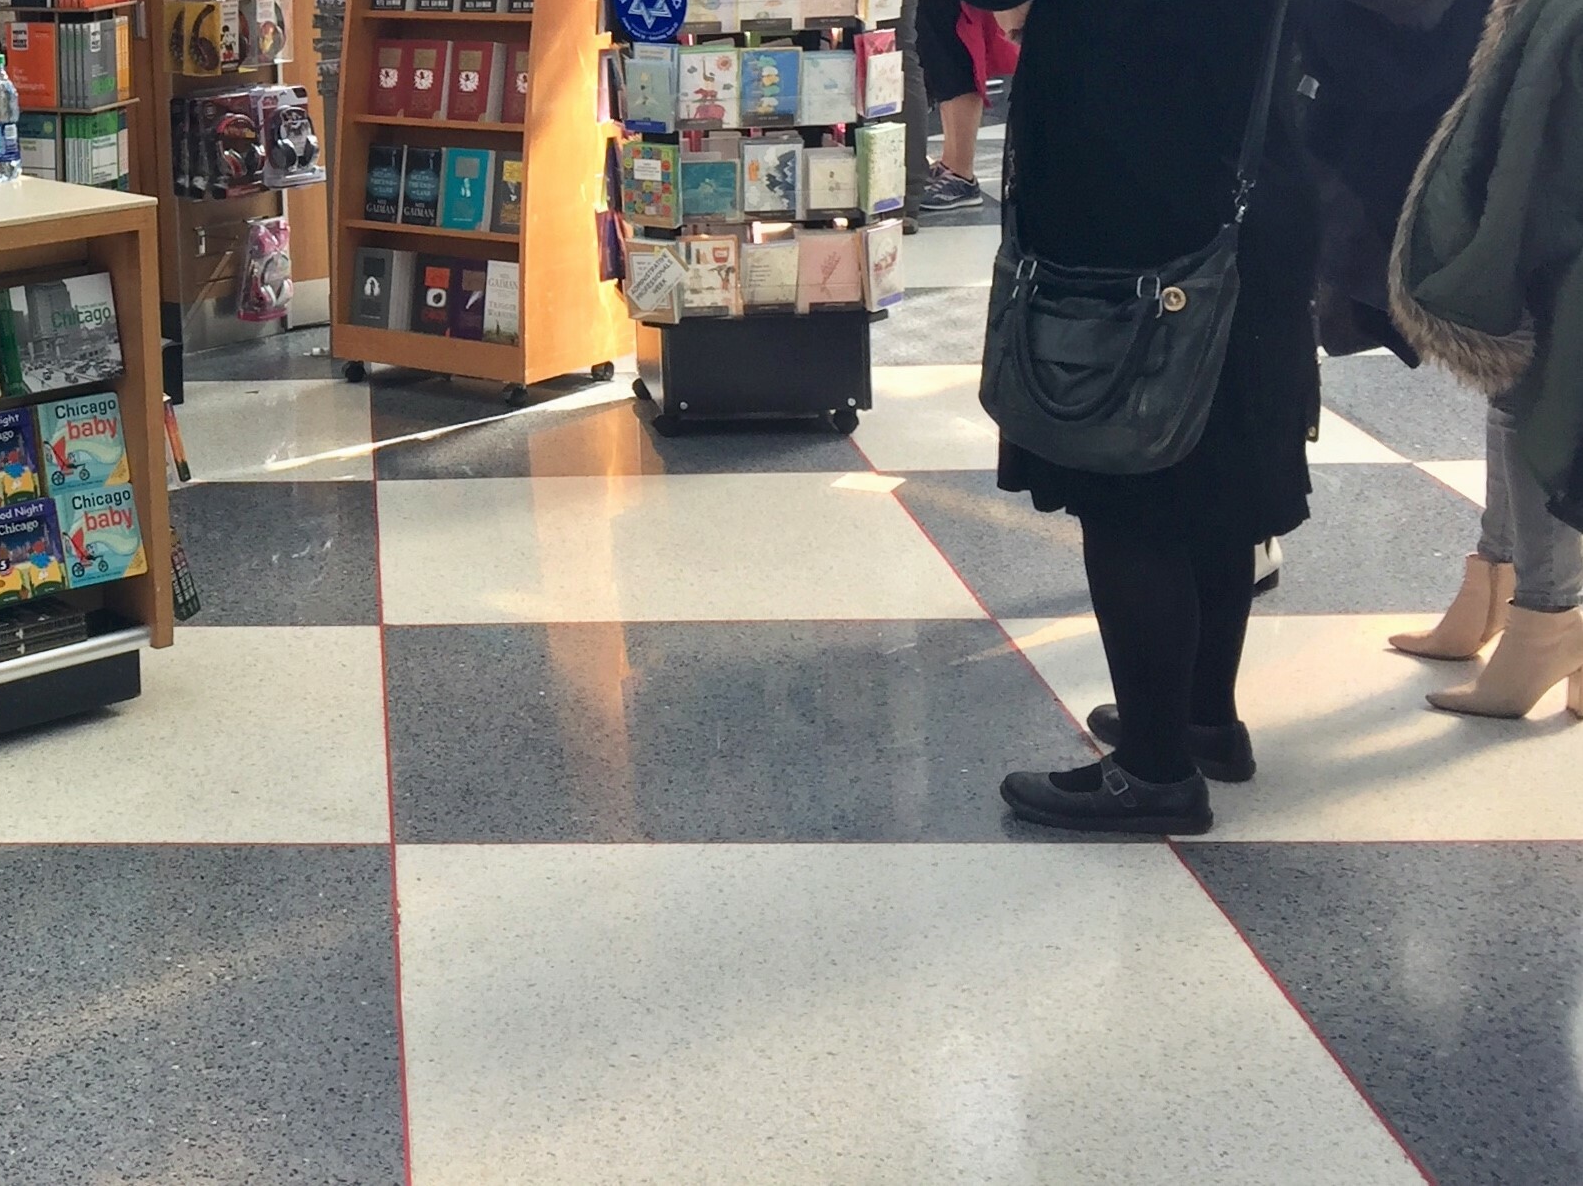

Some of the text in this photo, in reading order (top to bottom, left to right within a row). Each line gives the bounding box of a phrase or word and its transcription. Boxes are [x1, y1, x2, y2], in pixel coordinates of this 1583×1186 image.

[631, 252, 668, 295] ADMINISTRATIVE
[652, 278, 667, 294] WEEK
[55, 398, 116, 420] Chicago
[67, 415, 117, 440] baby
[15, 503, 44, 518] Night
[72, 489, 131, 511] Chicago
[84, 507, 134, 531] baby
